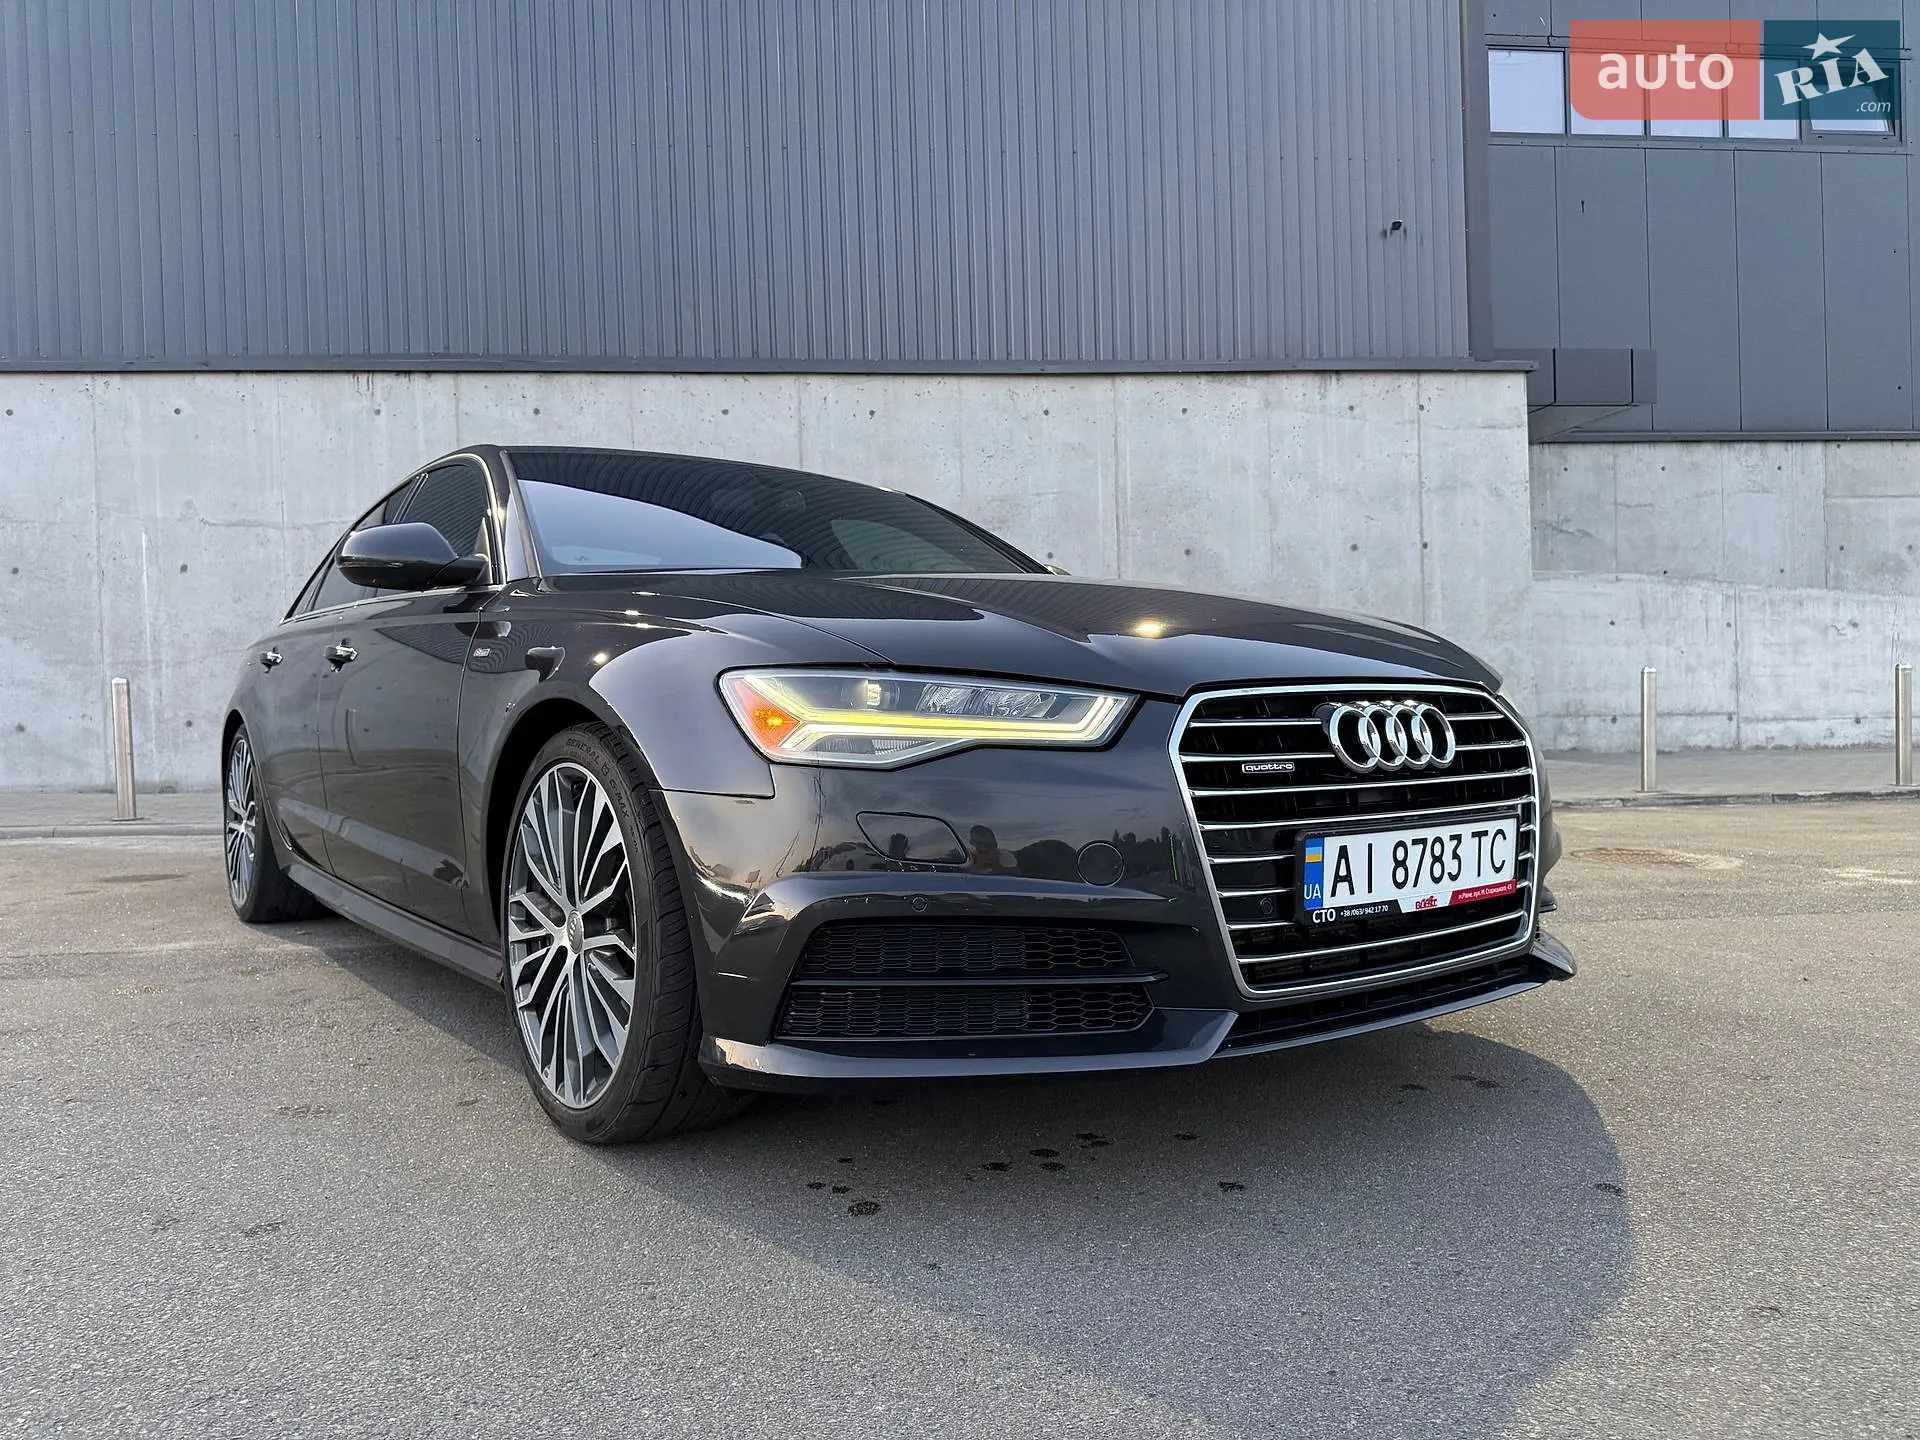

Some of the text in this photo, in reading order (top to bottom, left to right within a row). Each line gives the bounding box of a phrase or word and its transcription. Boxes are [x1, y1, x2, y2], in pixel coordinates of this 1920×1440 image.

[566, 738, 601, 766] GENERAL
[1245, 763, 1293, 772] quattro
[1330, 828, 1508, 898] AI 8783 TC
[1303, 883, 1322, 900] UA
